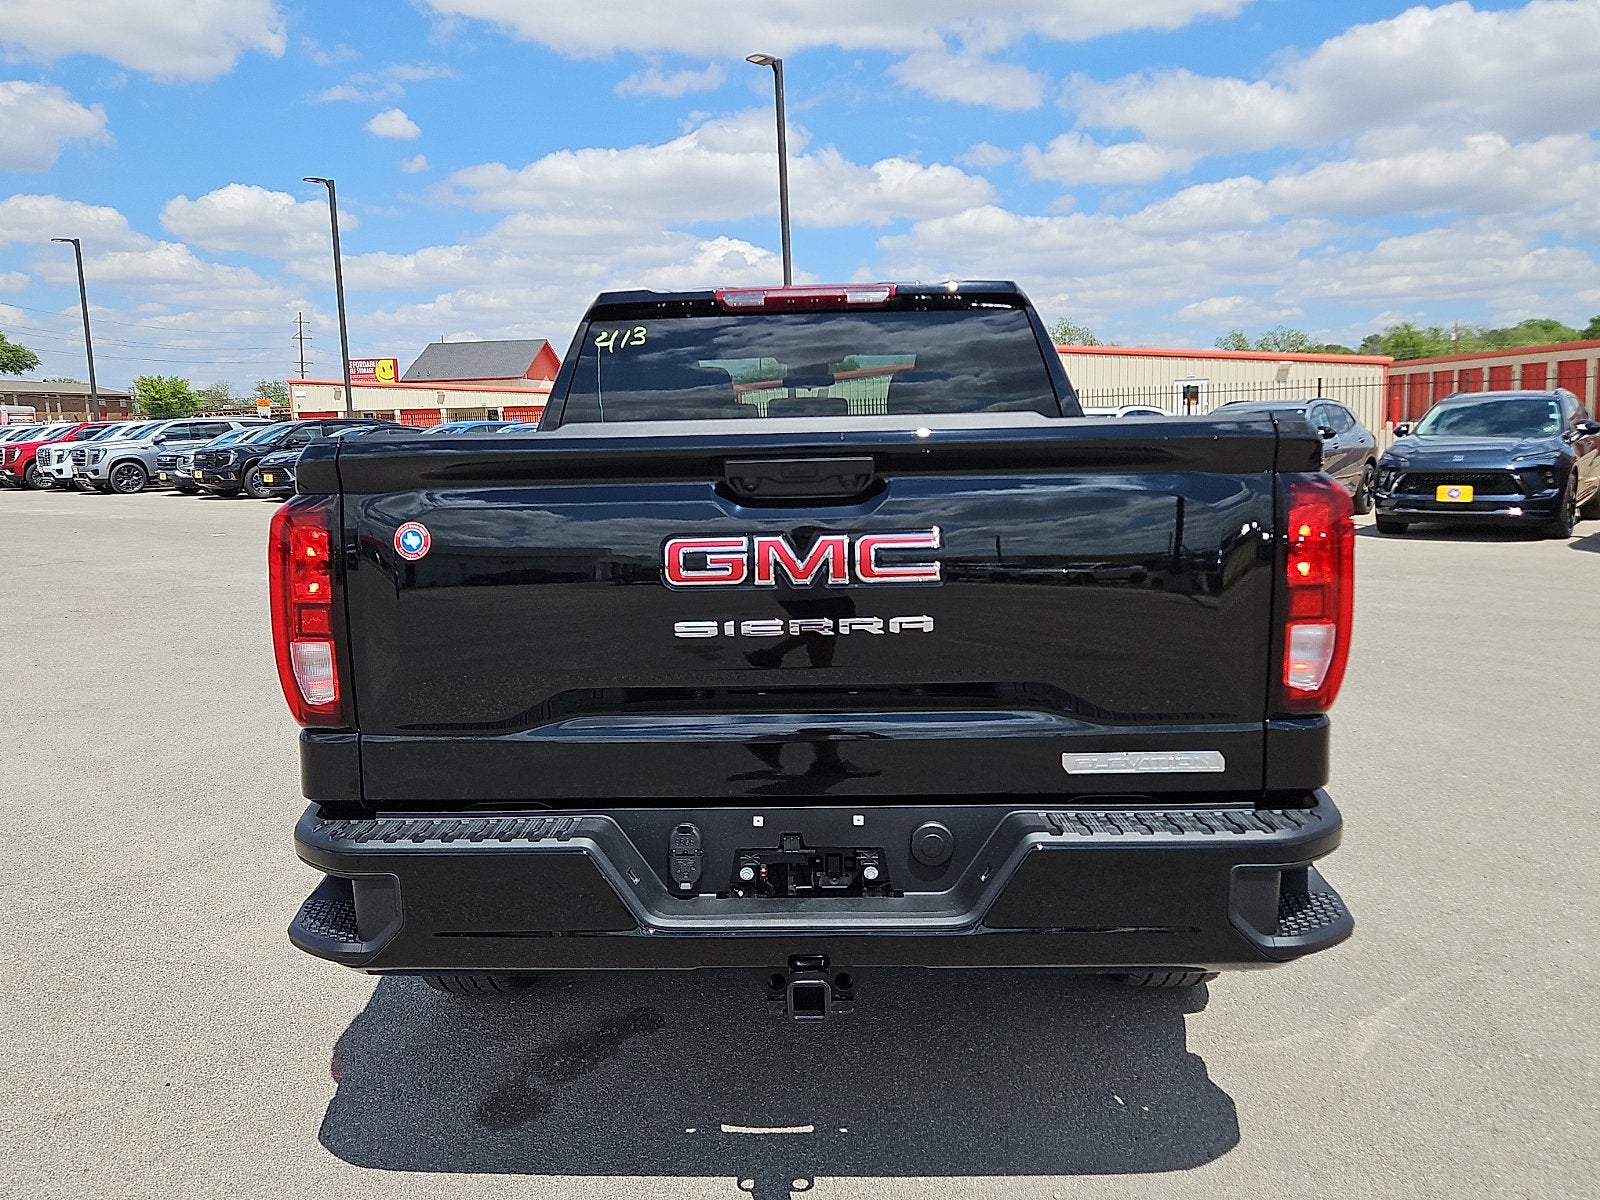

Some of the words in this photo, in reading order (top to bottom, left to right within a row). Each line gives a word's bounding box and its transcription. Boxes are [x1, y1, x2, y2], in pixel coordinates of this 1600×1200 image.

[349, 360, 379, 368] FFORDABLE
[664, 525, 941, 586] GMC
[673, 615, 934, 638] SIERRA
[1073, 755, 1220, 771] ELEVATION
